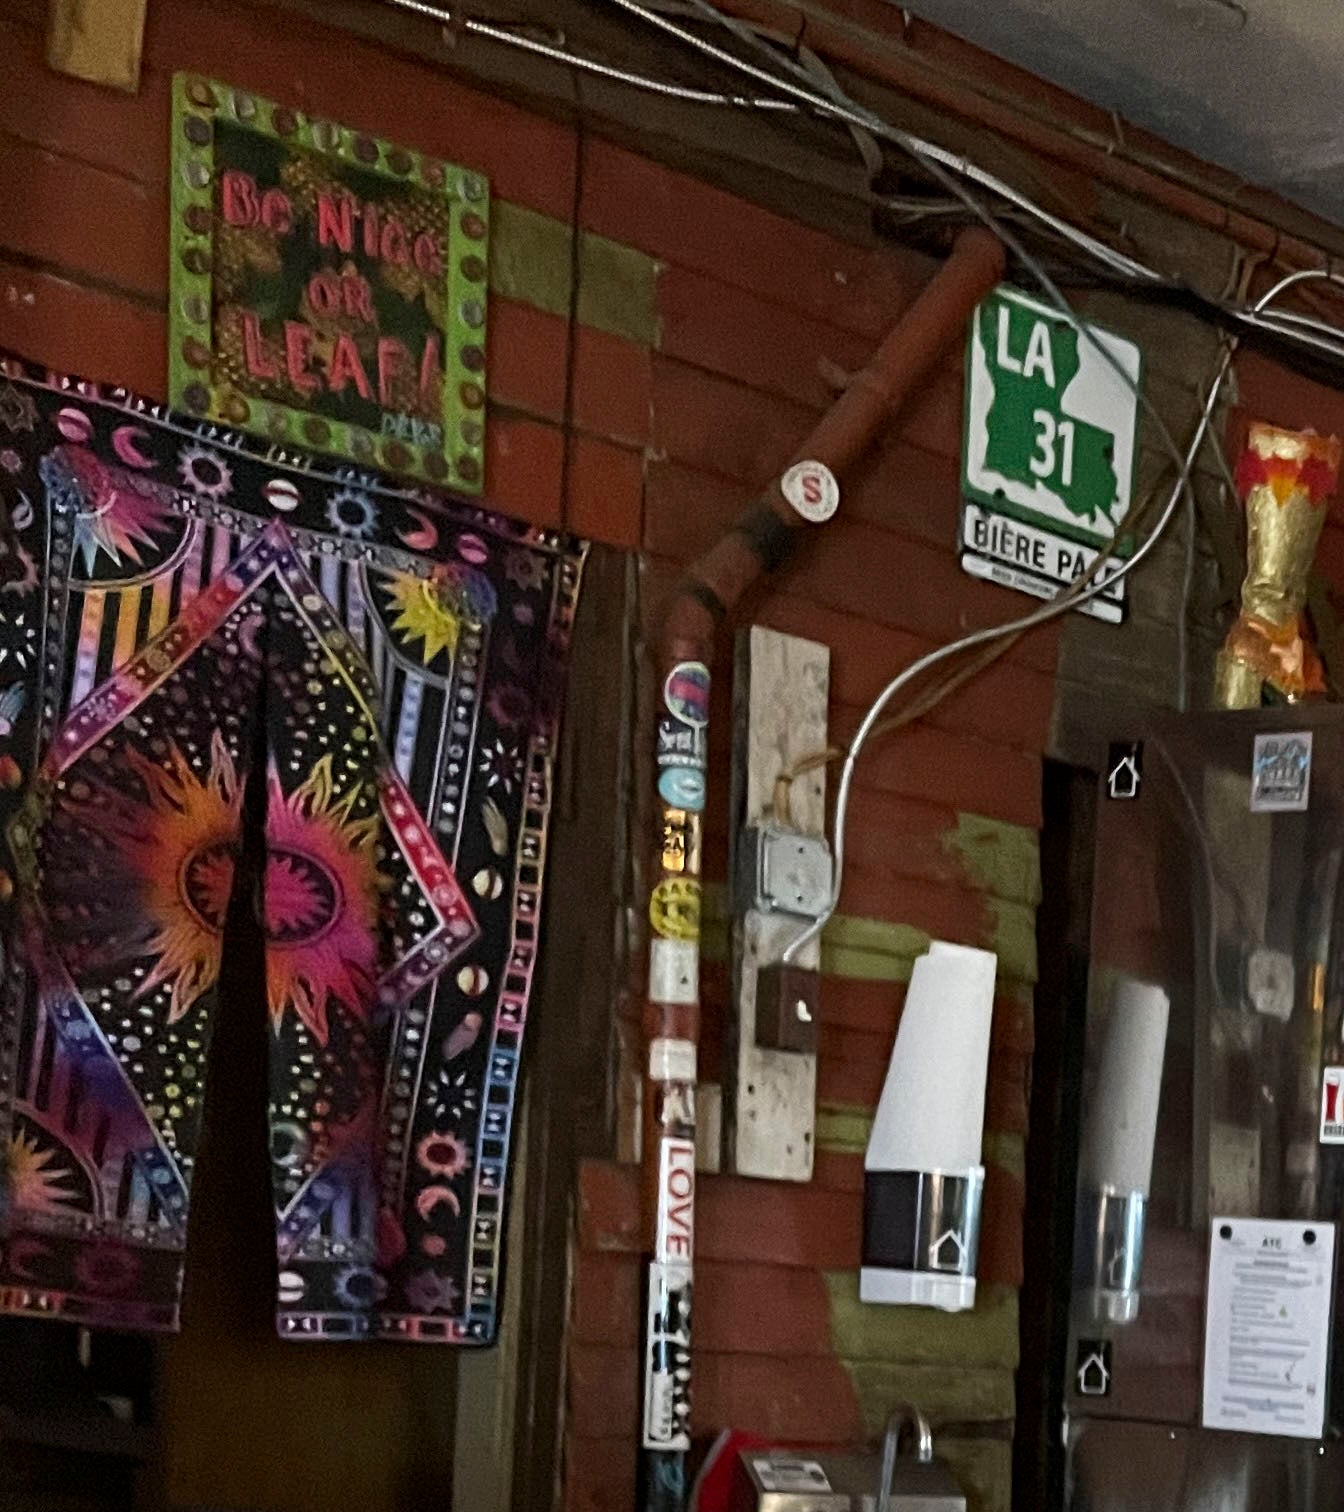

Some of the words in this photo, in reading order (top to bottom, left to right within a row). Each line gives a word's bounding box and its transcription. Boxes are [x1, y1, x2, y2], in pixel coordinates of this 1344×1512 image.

[997, 305, 1055, 388] LA
[1029, 409, 1075, 486] 31
[665, 1146, 692, 1258] LOVE
